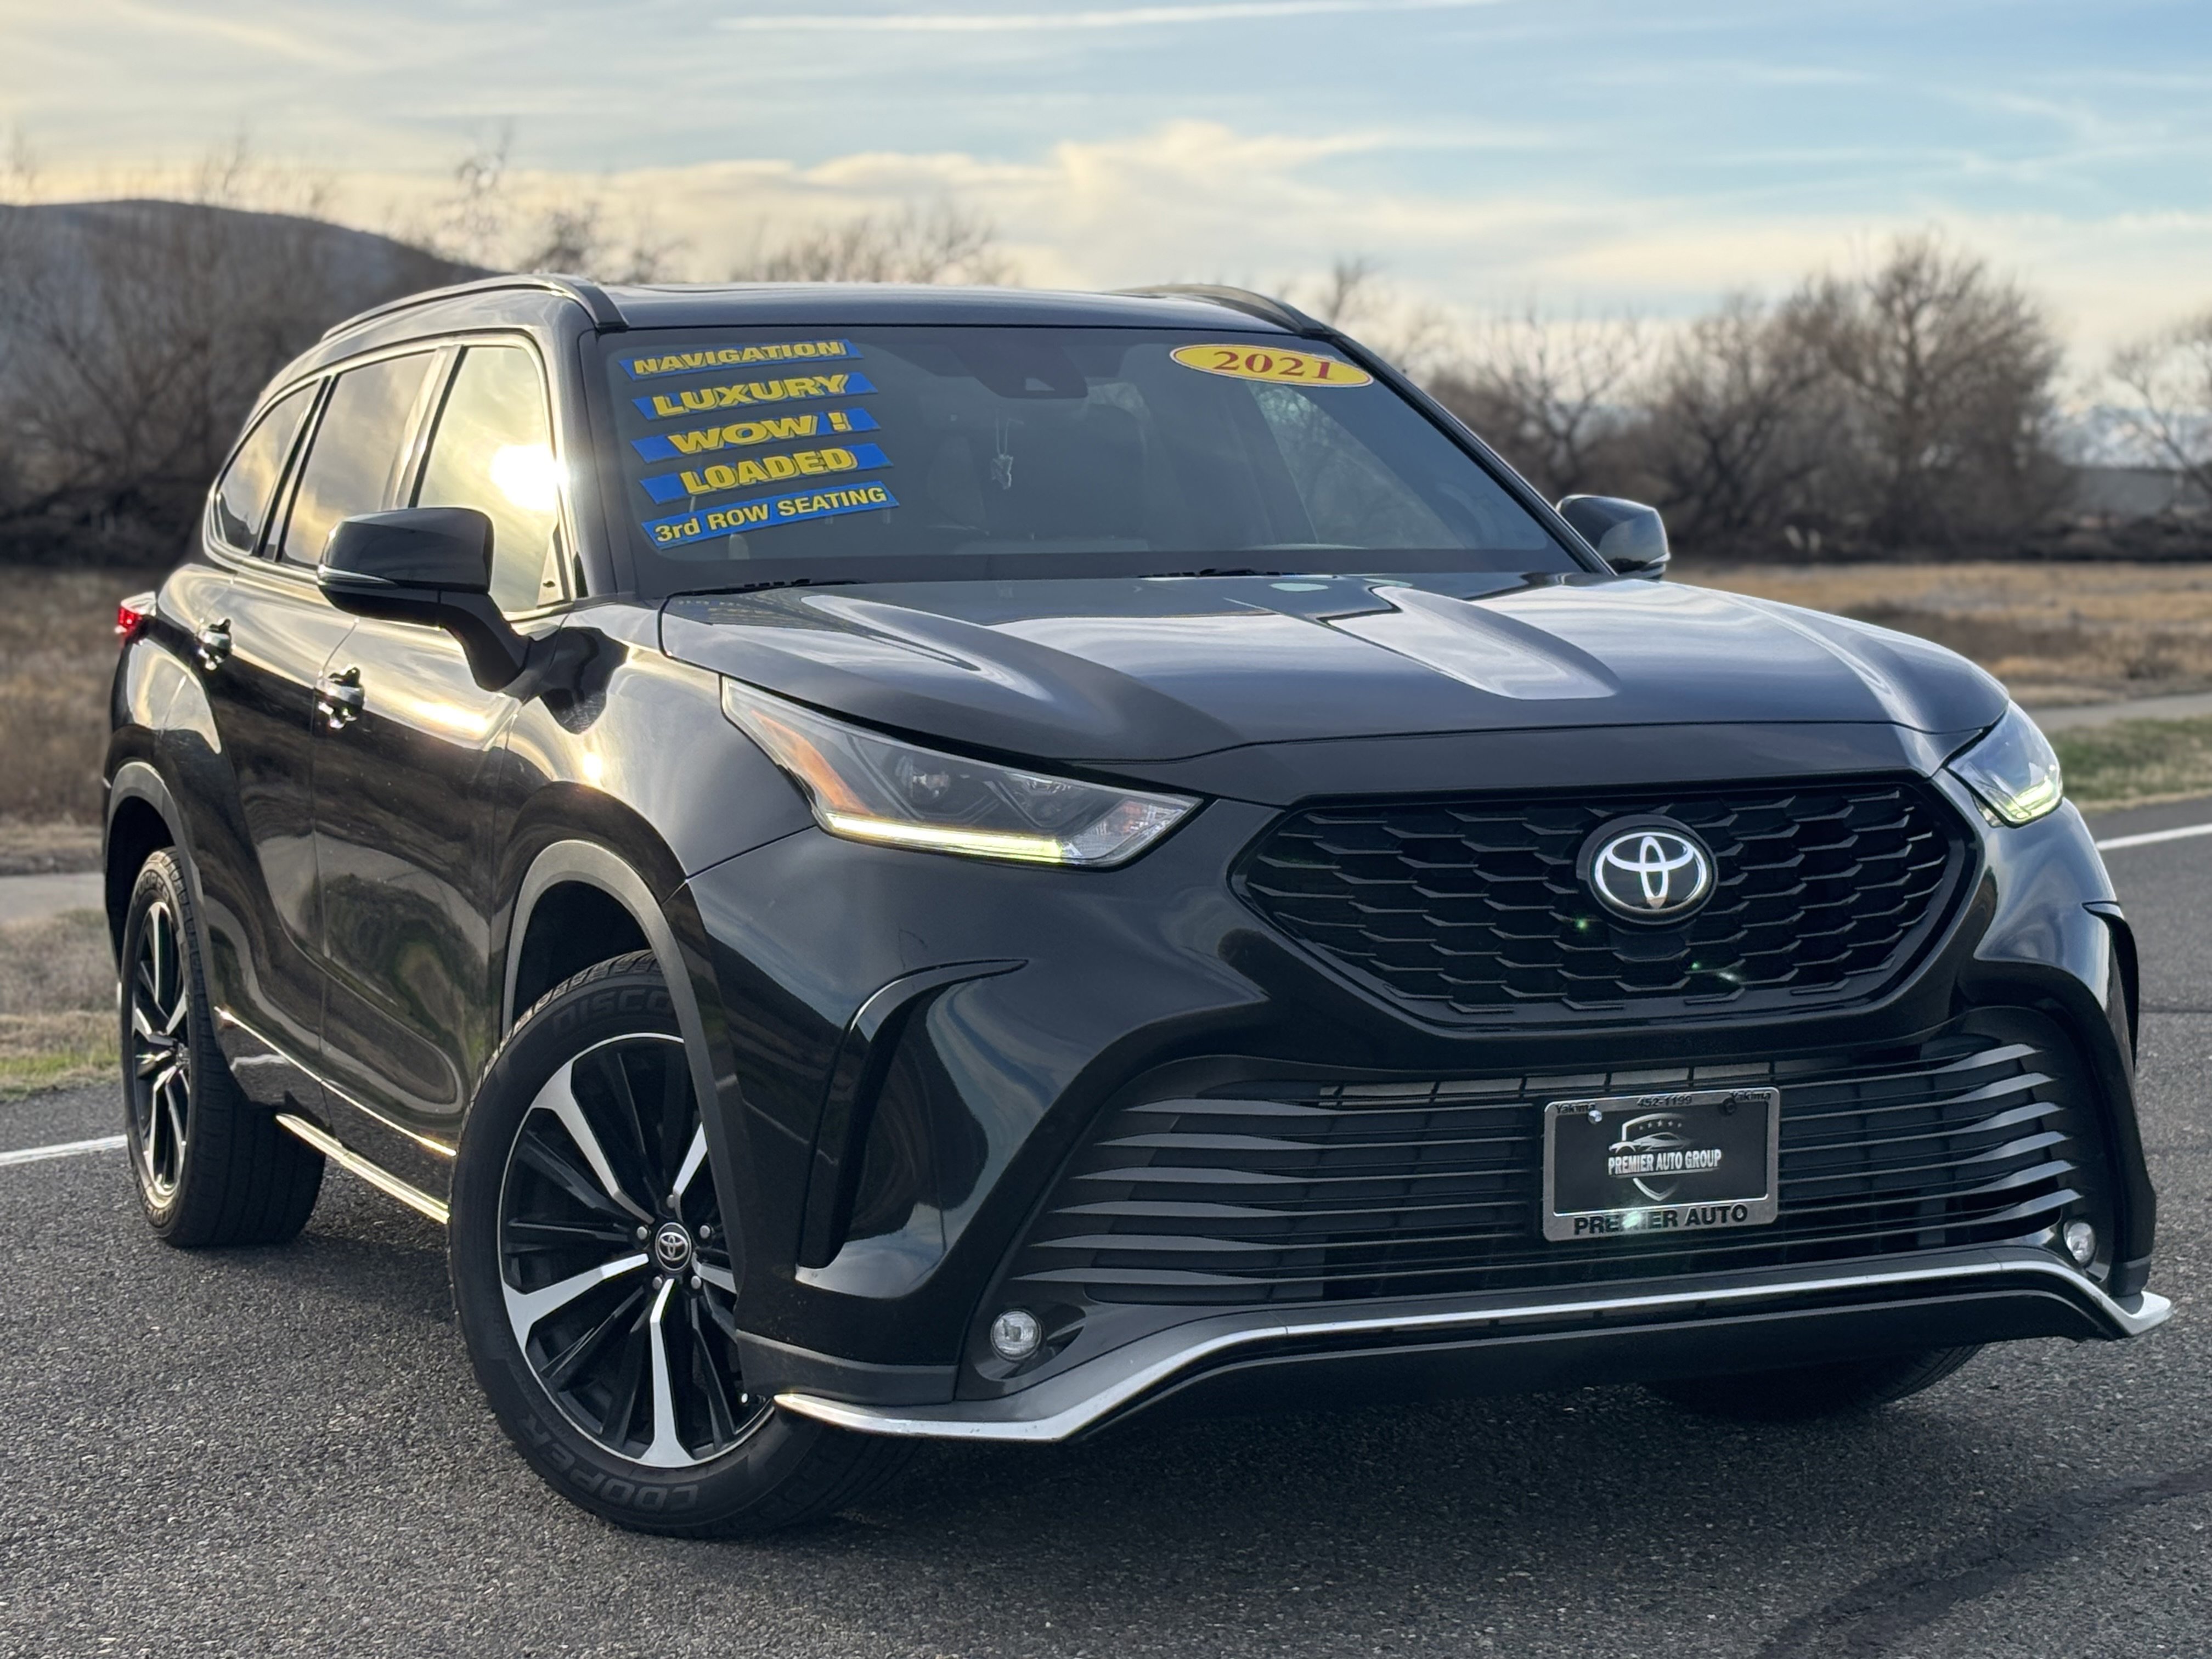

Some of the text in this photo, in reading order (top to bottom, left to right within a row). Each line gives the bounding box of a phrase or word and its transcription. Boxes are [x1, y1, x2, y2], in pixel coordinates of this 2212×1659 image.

[634, 342, 847, 375] NAVIGATION
[1214, 351, 1334, 380] 2021
[652, 374, 849, 416] LUXURY
[668, 411, 851, 454] WOW !
[681, 448, 858, 495] LOADED
[655, 487, 887, 543] 3rd ROW SEATING
[1637, 1095, 1692, 1107] 452-1199
[1608, 1149, 1722, 1175] PREMIER AUTO GROUP
[1573, 1204, 1748, 1235] PREER AUTO
[516, 1413, 699, 1511] COOPER
